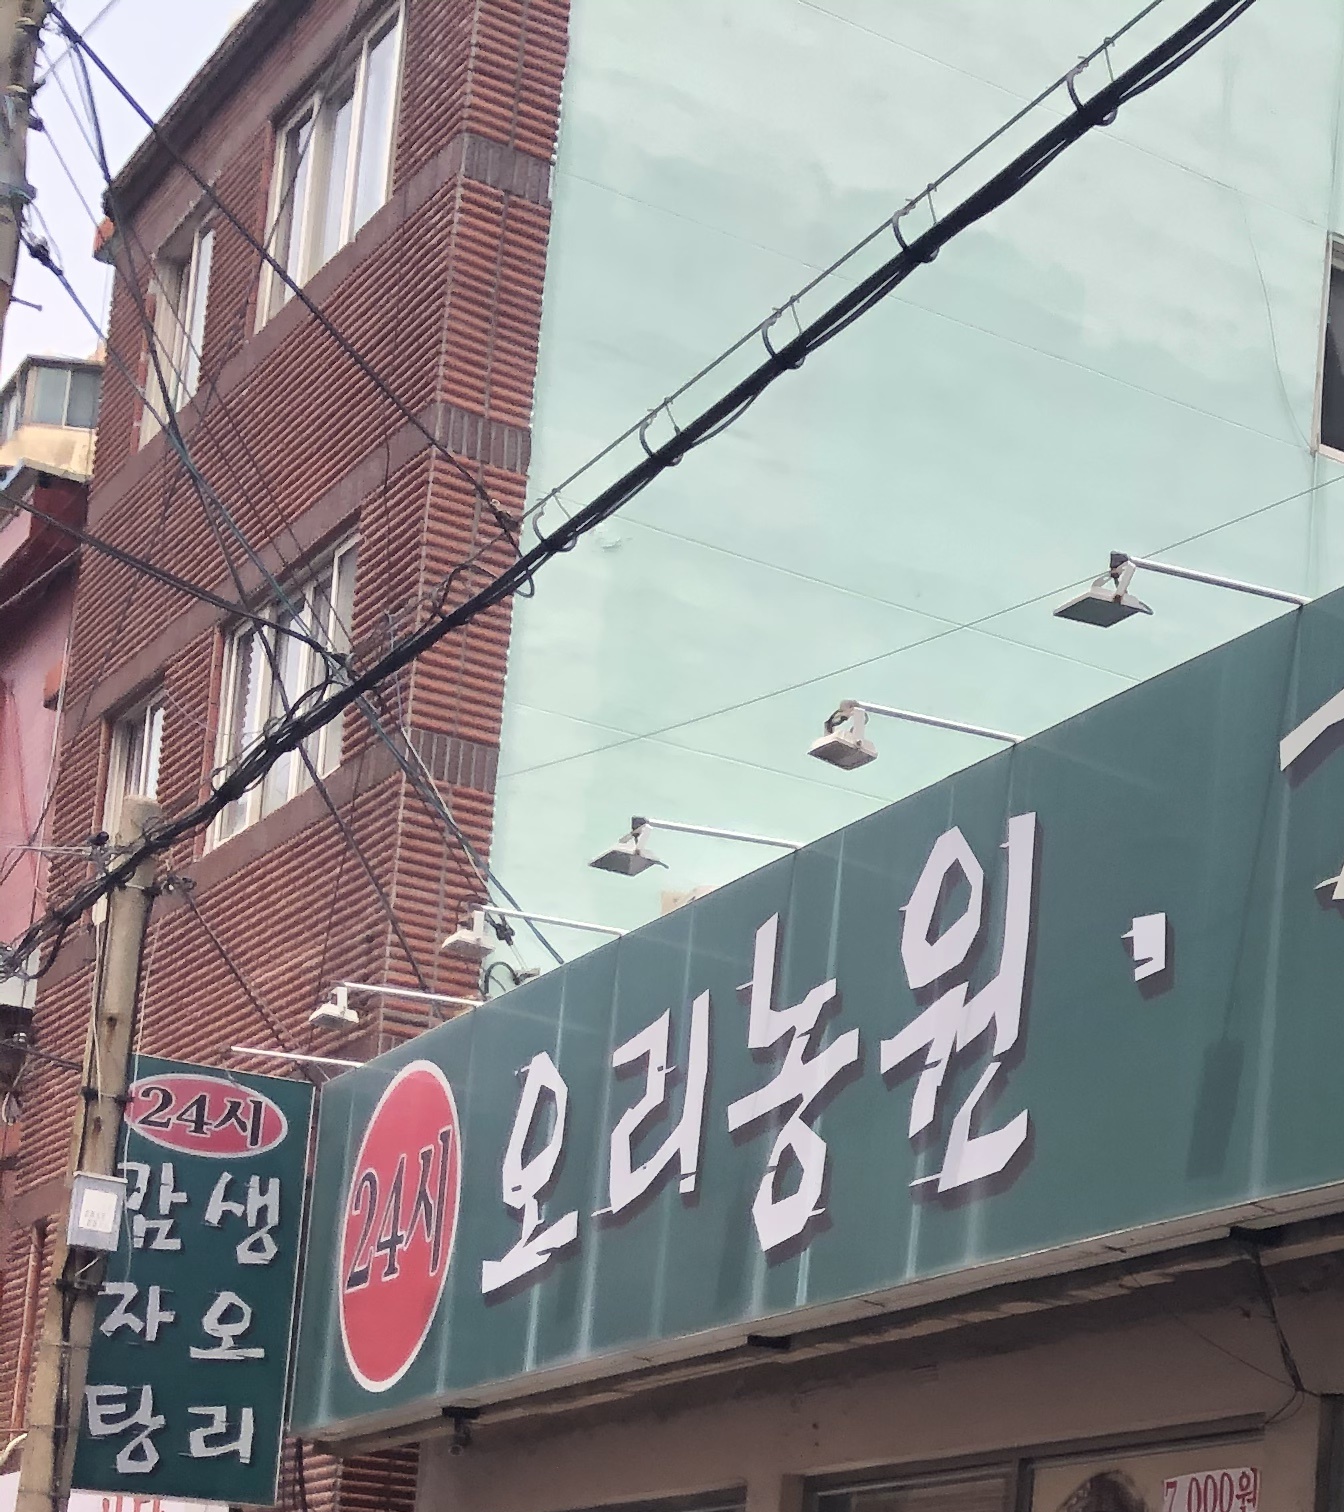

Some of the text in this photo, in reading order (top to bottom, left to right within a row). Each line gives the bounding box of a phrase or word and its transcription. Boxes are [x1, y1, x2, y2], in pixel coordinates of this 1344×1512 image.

[136, 1087, 264, 1150] 24시
[344, 1128, 452, 1294] 24시
[482, 812, 1036, 1294] 오리농원
[85, 1160, 188, 1474] 감자탕
[180, 1170, 281, 1465] 생오리
